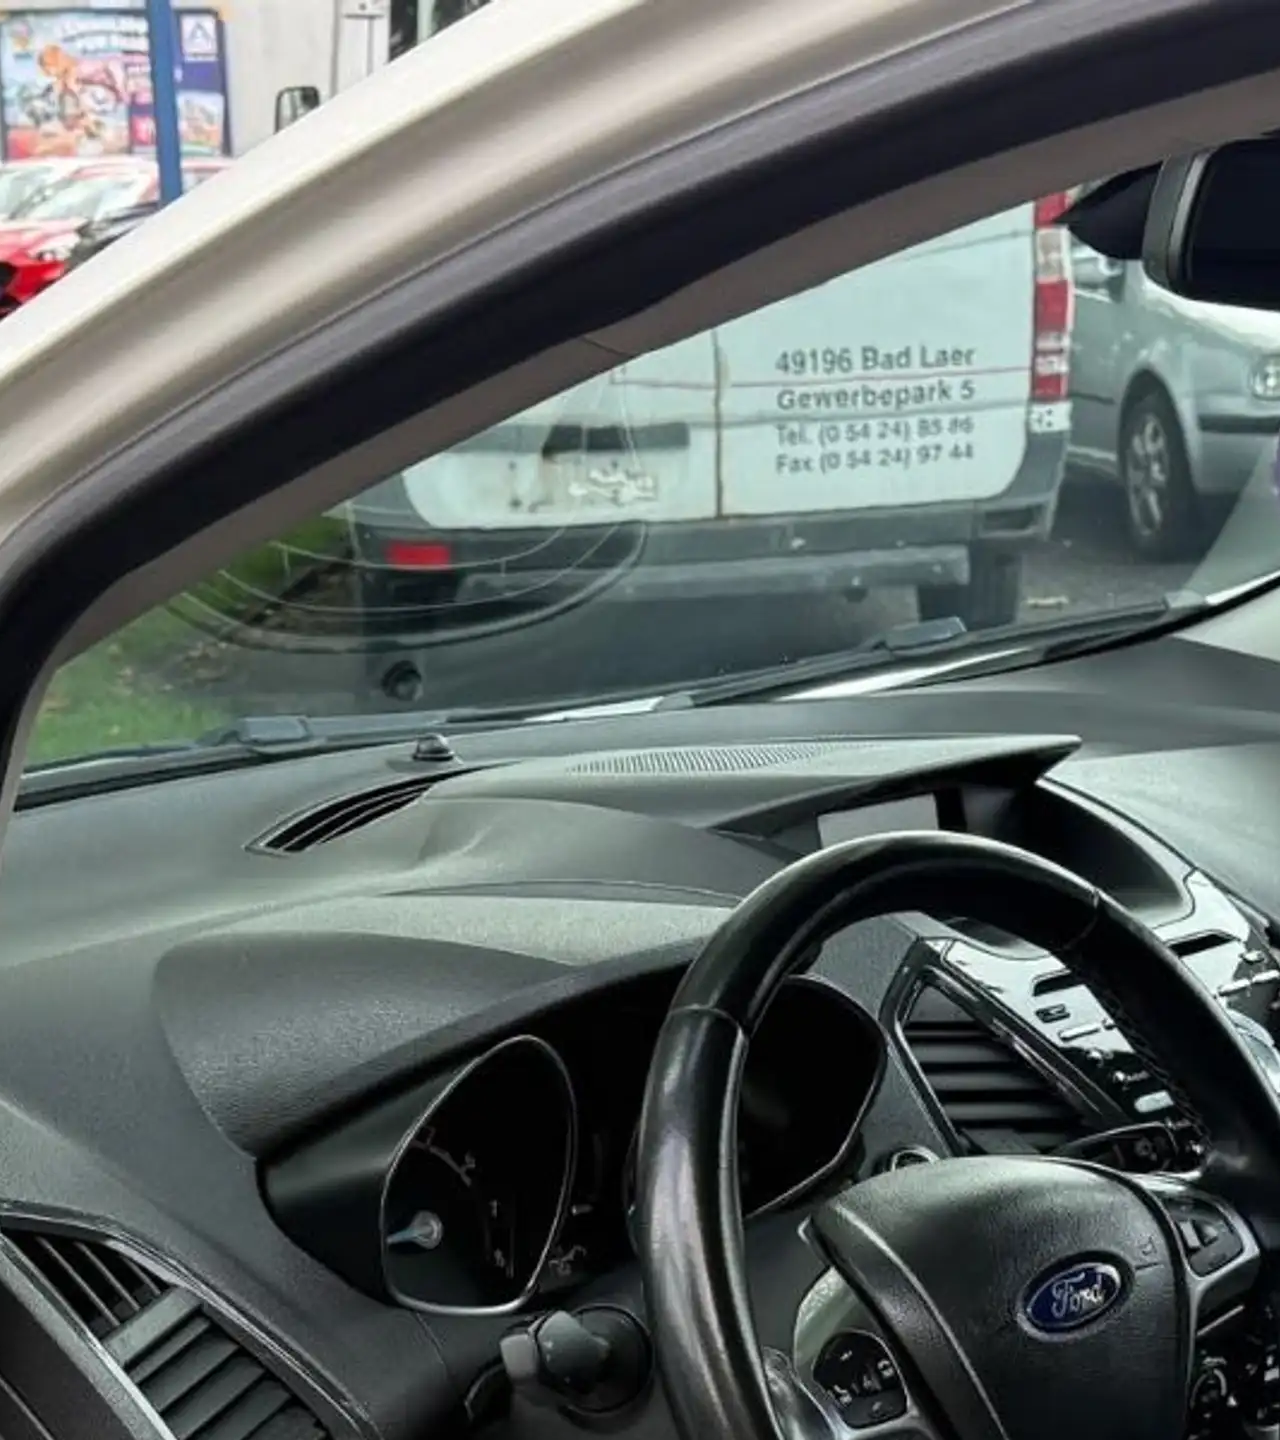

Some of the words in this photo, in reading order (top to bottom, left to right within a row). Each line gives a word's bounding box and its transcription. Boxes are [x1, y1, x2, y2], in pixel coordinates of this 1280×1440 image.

[775, 347, 853, 375] 49196
[861, 346, 911, 371] Bad
[920, 345, 976, 369] Laer
[776, 378, 952, 411] Gewerbepark
[960, 379, 976, 401] 5
[775, 421, 812, 446] Tel.
[818, 424, 841, 449] (0
[845, 423, 871, 443] 54
[876, 420, 911, 443] 24)
[775, 453, 814, 474] Fax
[819, 452, 841, 475] (0
[845, 450, 871, 470] 54
[876, 447, 911, 471] 24)
[917, 443, 943, 465] 97
[948, 442, 974, 461] 44
[1051, 1271, 1103, 1320] Ford
